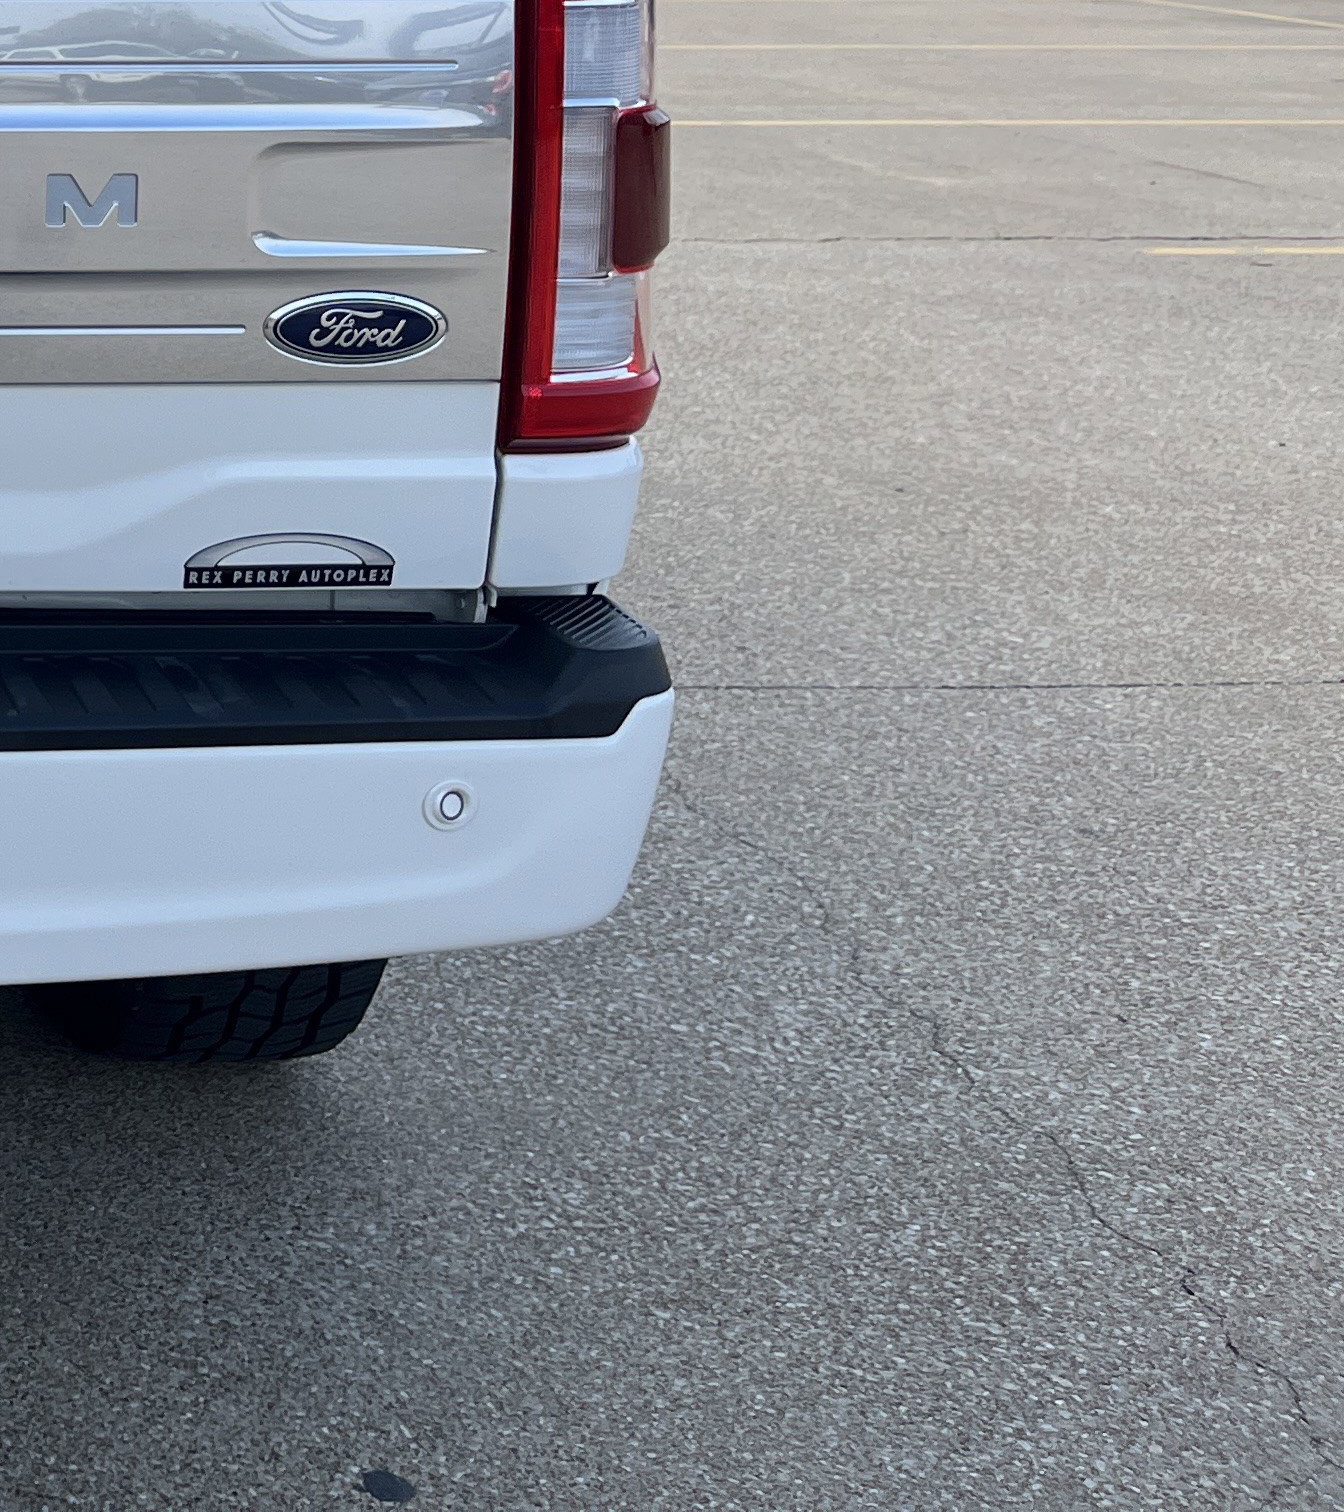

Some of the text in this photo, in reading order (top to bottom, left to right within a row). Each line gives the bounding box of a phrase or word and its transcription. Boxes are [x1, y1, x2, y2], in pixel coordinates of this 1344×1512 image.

[308, 308, 407, 348] Ford
[188, 568, 391, 584] REX PERRY AUTOPLEX
